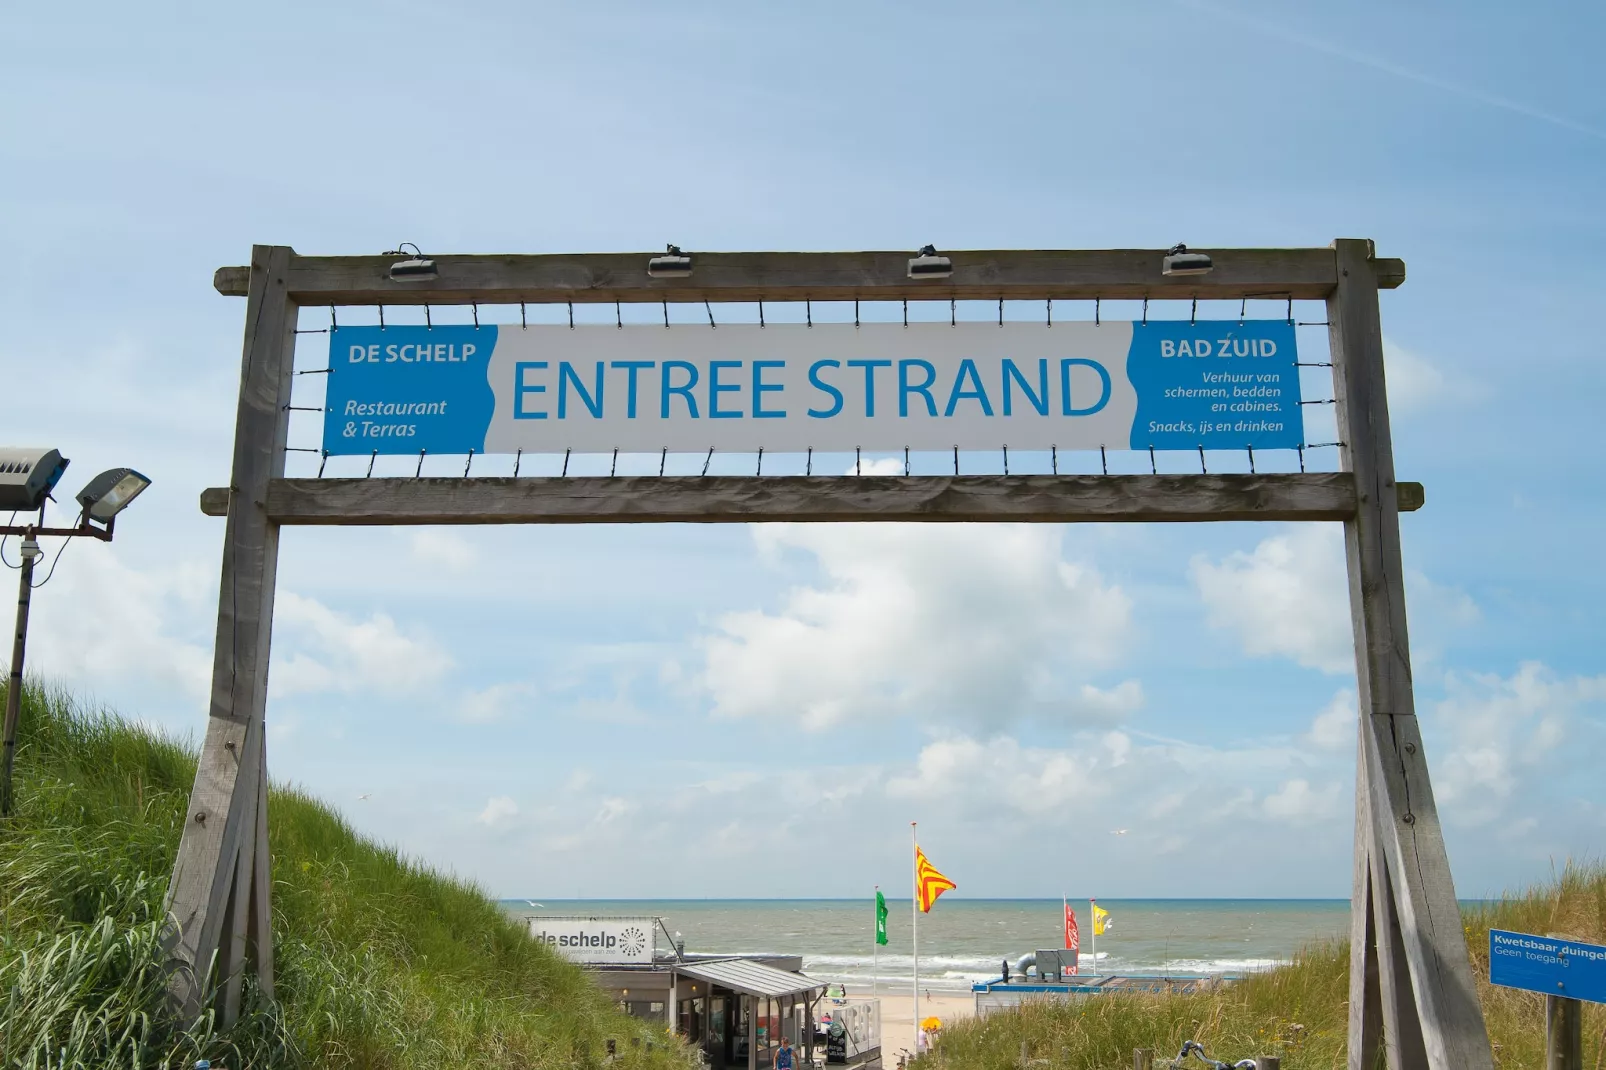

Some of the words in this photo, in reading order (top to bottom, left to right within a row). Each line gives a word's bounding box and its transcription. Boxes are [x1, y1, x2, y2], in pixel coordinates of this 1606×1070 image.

[349, 345, 380, 363] DE
[385, 343, 476, 363] SCHELP
[1161, 339, 1212, 358] BAD
[1217, 339, 1277, 358] ZUID
[1202, 372, 1253, 383] Verhuur
[1256, 374, 1280, 383] van
[513, 360, 787, 419] ENTREE
[807, 358, 1112, 419] STRAND
[1164, 386, 1230, 398] schermen,
[1233, 386, 1281, 397] bedden
[344, 399, 447, 416] Restaurant
[1211, 402, 1226, 412] en
[1230, 400, 1282, 412] cabines.
[343, 422, 358, 438] &
[361, 421, 416, 437] Terras
[1148, 421, 1196, 433] Snacks,
[1199, 421, 1213, 435] ijs
[1216, 422, 1232, 432] en
[1234, 421, 1283, 432] drinken
[559, 931, 616, 948] schelp
[1494, 934, 1558, 952] Kwetsbaar
[1494, 945, 1522, 958] Geen
[1526, 951, 1570, 967] toegang
